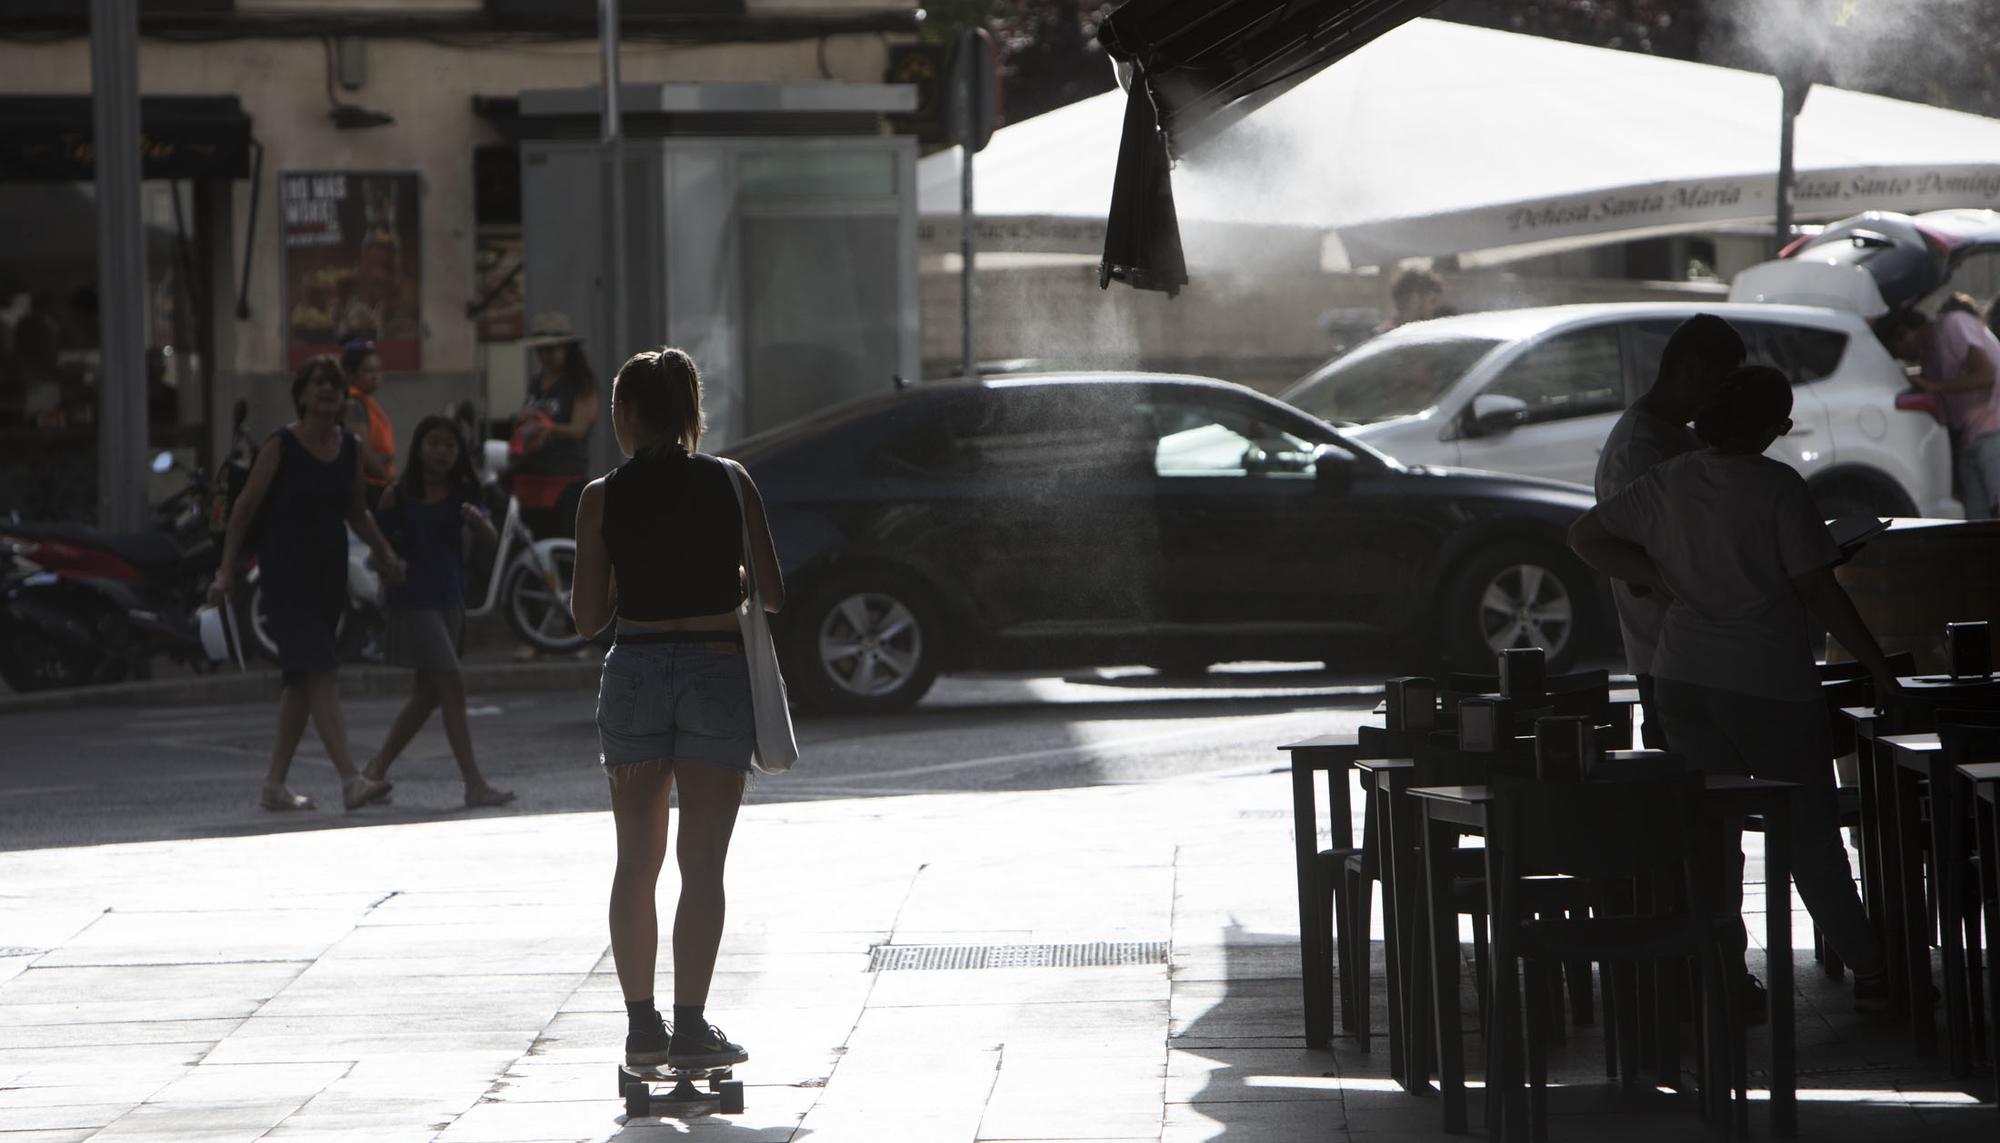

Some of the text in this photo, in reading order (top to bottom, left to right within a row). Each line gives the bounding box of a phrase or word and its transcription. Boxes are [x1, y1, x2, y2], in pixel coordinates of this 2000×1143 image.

[1506, 201, 1589, 230] Dehesa
[1593, 195, 1664, 220] Santa
[1843, 174, 1912, 199] Santo
[1916, 171, 2000, 201] Doming
